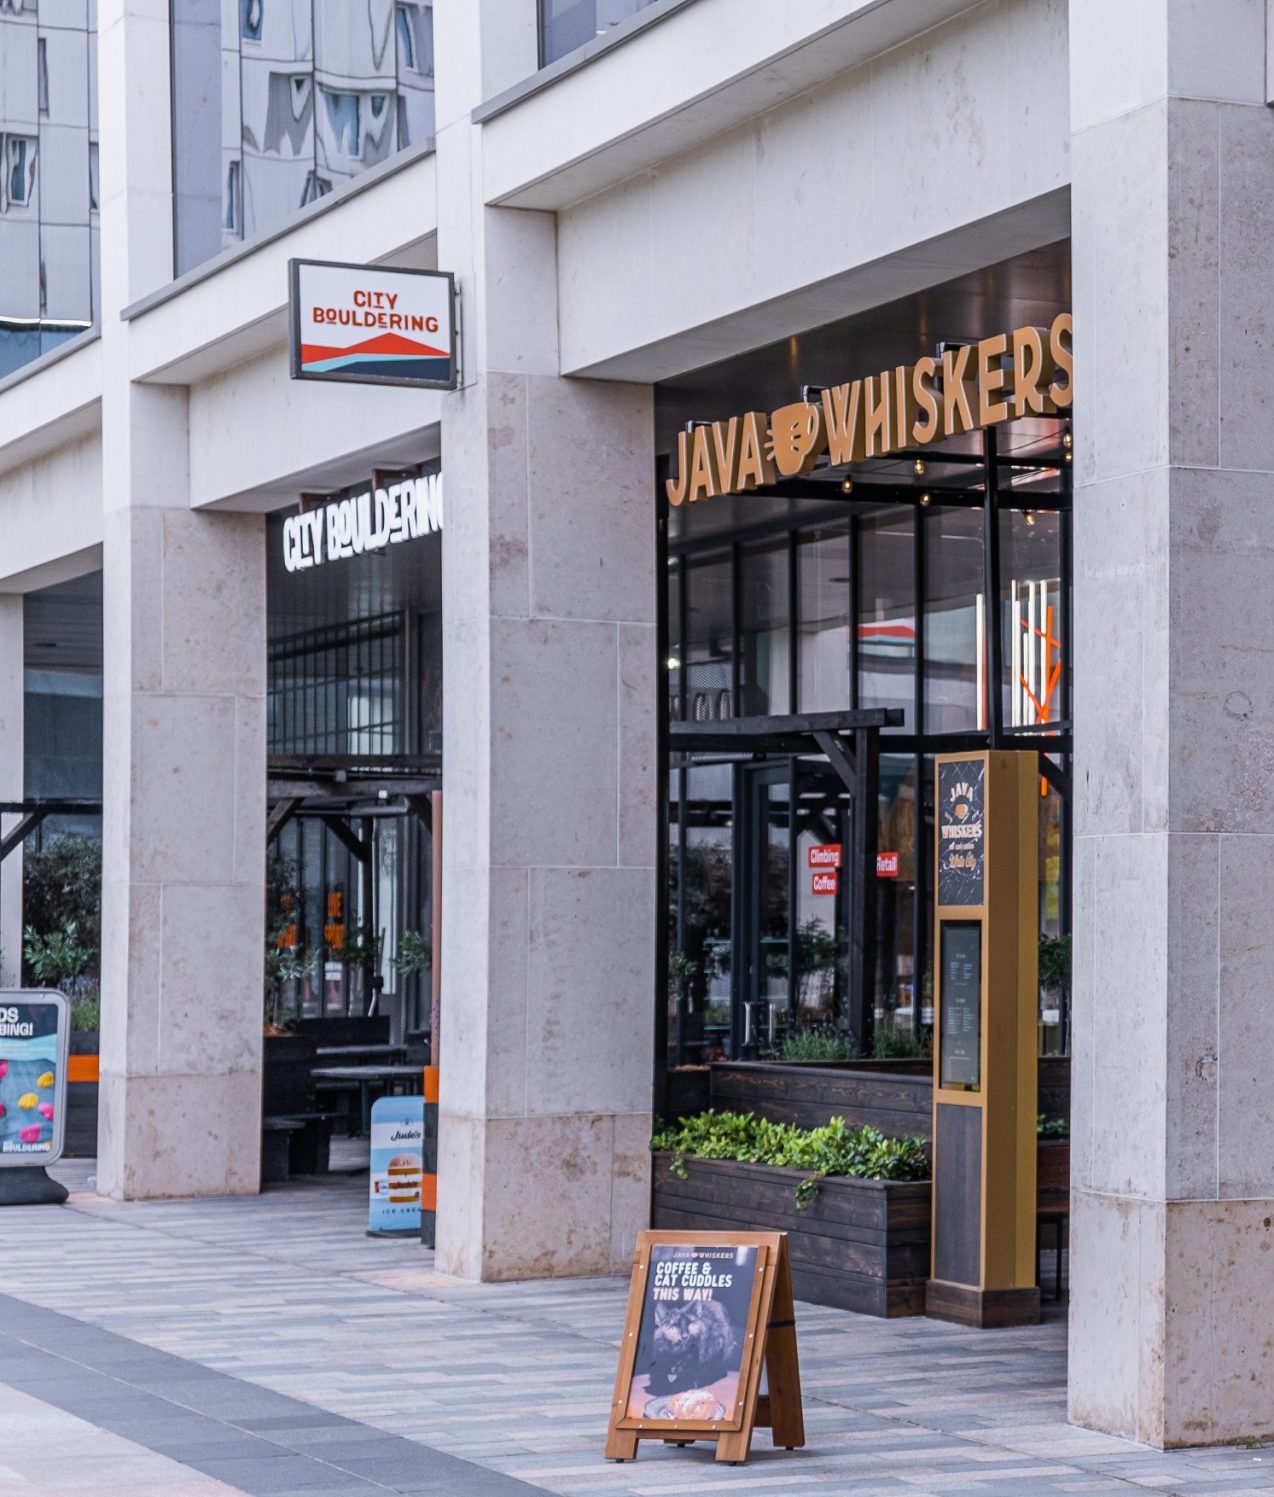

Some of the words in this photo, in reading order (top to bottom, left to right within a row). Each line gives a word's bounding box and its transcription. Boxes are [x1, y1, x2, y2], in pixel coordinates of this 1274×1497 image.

[353, 290, 398, 309] CITY
[312, 306, 439, 333] BOULDERING
[666, 410, 769, 507] JAVA
[820, 312, 1072, 466] WHISKERS
[283, 507, 324, 573] CITY
[950, 782, 974, 802] JAVA
[810, 847, 840, 867] Climbing
[876, 855, 898, 872] Retail
[813, 875, 836, 891] Coffee
[390, 1129, 422, 1141] Jude's
[672, 1251, 691, 1259] JAVA
[698, 1251, 734, 1259] WHISKERS
[656, 1261, 699, 1275] COFFEE
[701, 1261, 712, 1275] &
[654, 1273, 678, 1287] CAT
[681, 1274, 733, 1288] CUDDLES
[653, 1287, 680, 1301] THIS
[683, 1288, 713, 1301] WAY!
